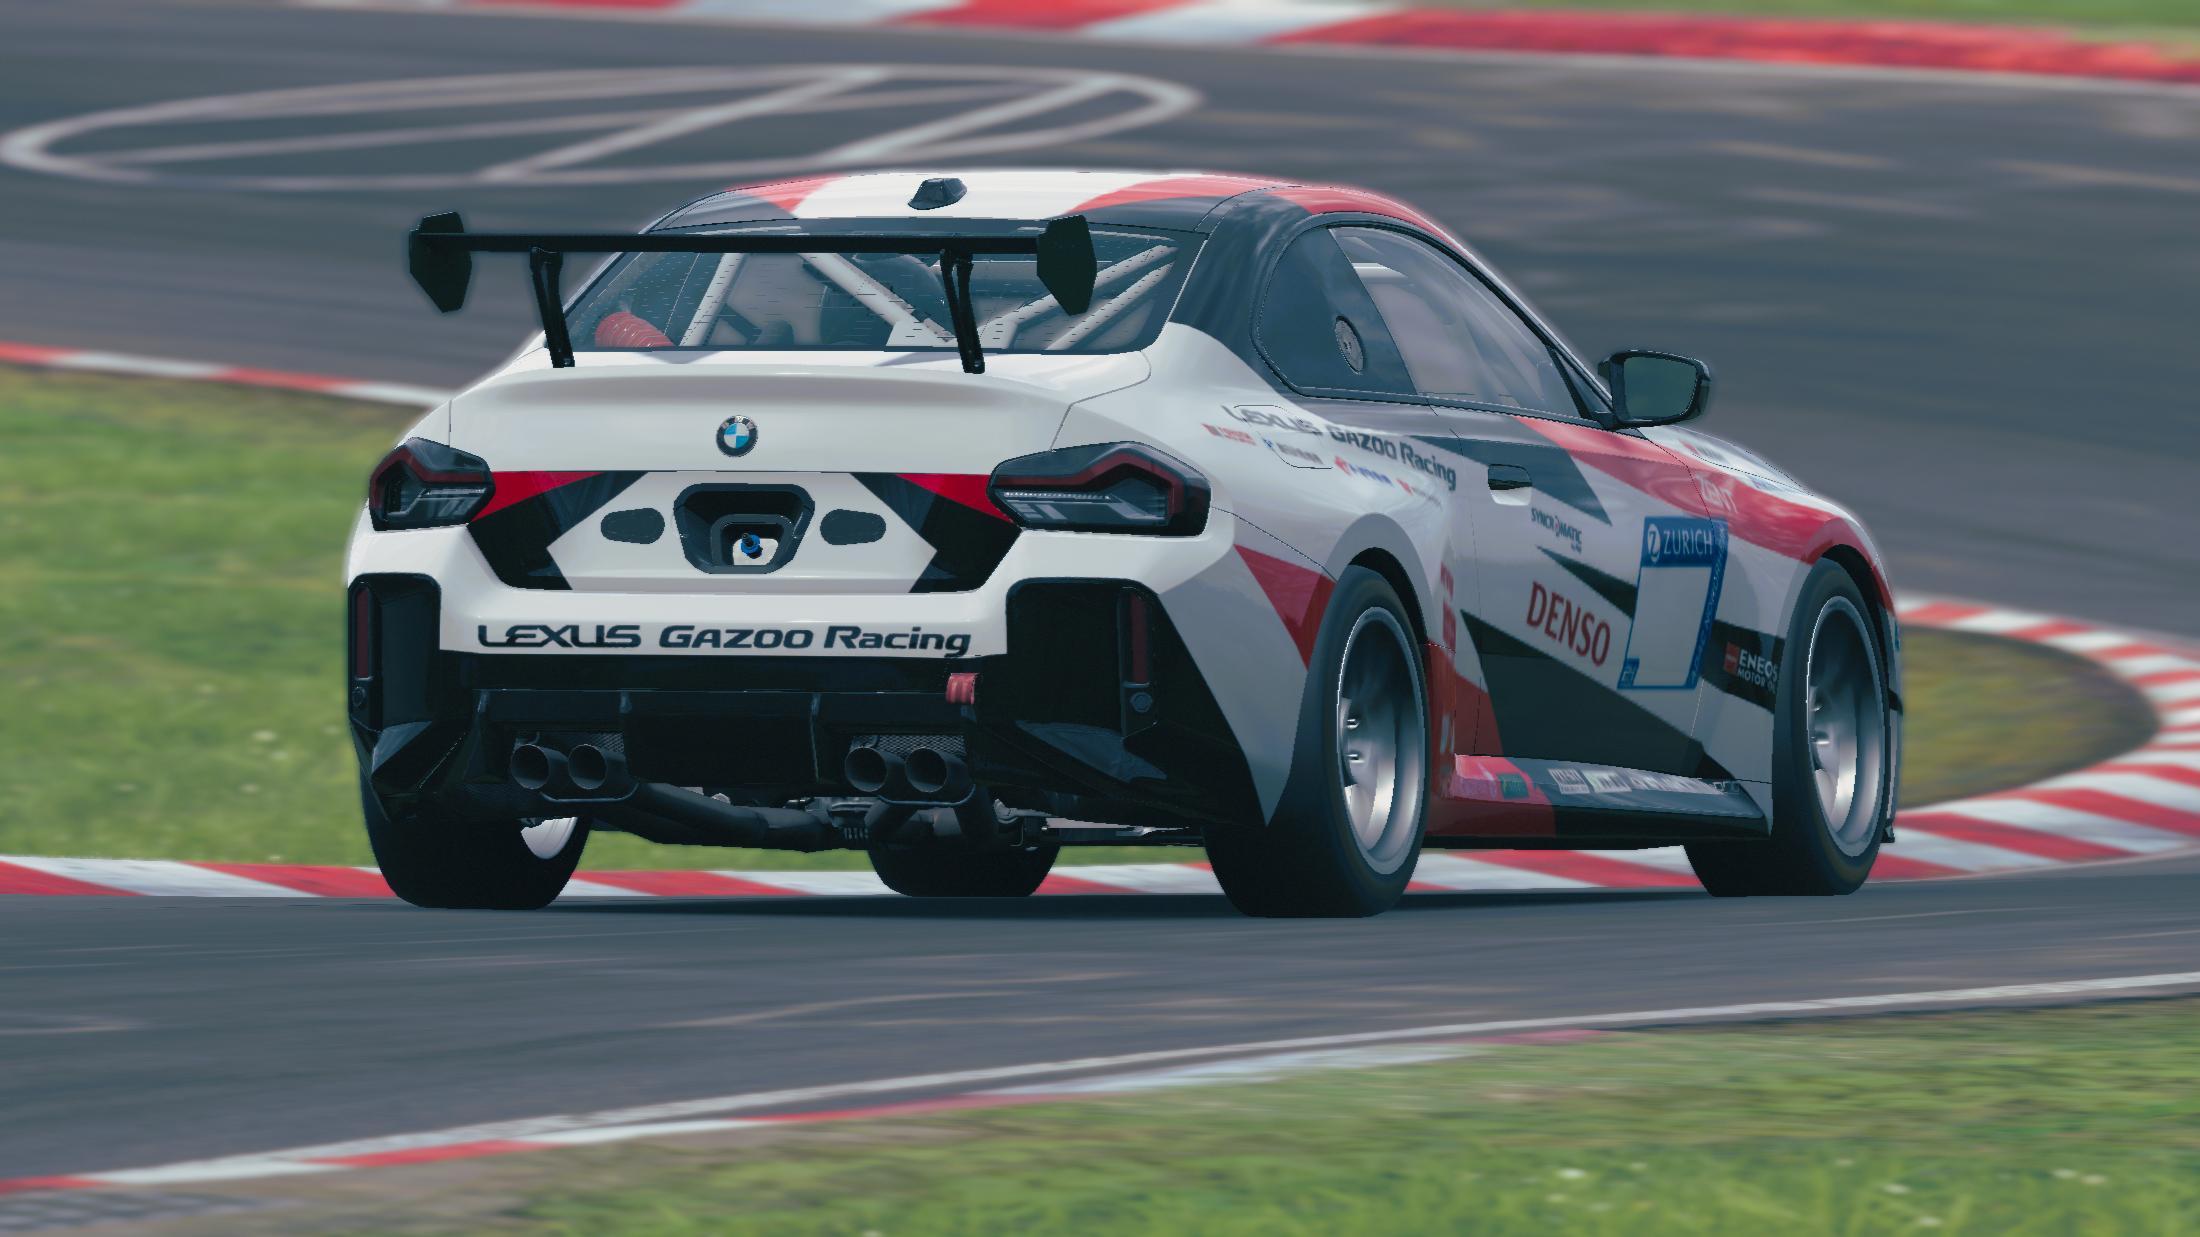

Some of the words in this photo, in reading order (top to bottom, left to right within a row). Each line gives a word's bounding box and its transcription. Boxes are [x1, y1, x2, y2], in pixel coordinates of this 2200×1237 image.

[1221, 404, 1323, 436] LEXUS
[1326, 425, 1398, 460] GAZOO
[1400, 441, 1456, 491] Racing
[1663, 529, 1713, 555] ZURICH
[1526, 580, 1611, 667] DENSO
[478, 625, 642, 648] LEXUS
[659, 625, 814, 649] GAZOO
[824, 625, 972, 658] Racing
[1737, 666, 1766, 688] MOTOR
